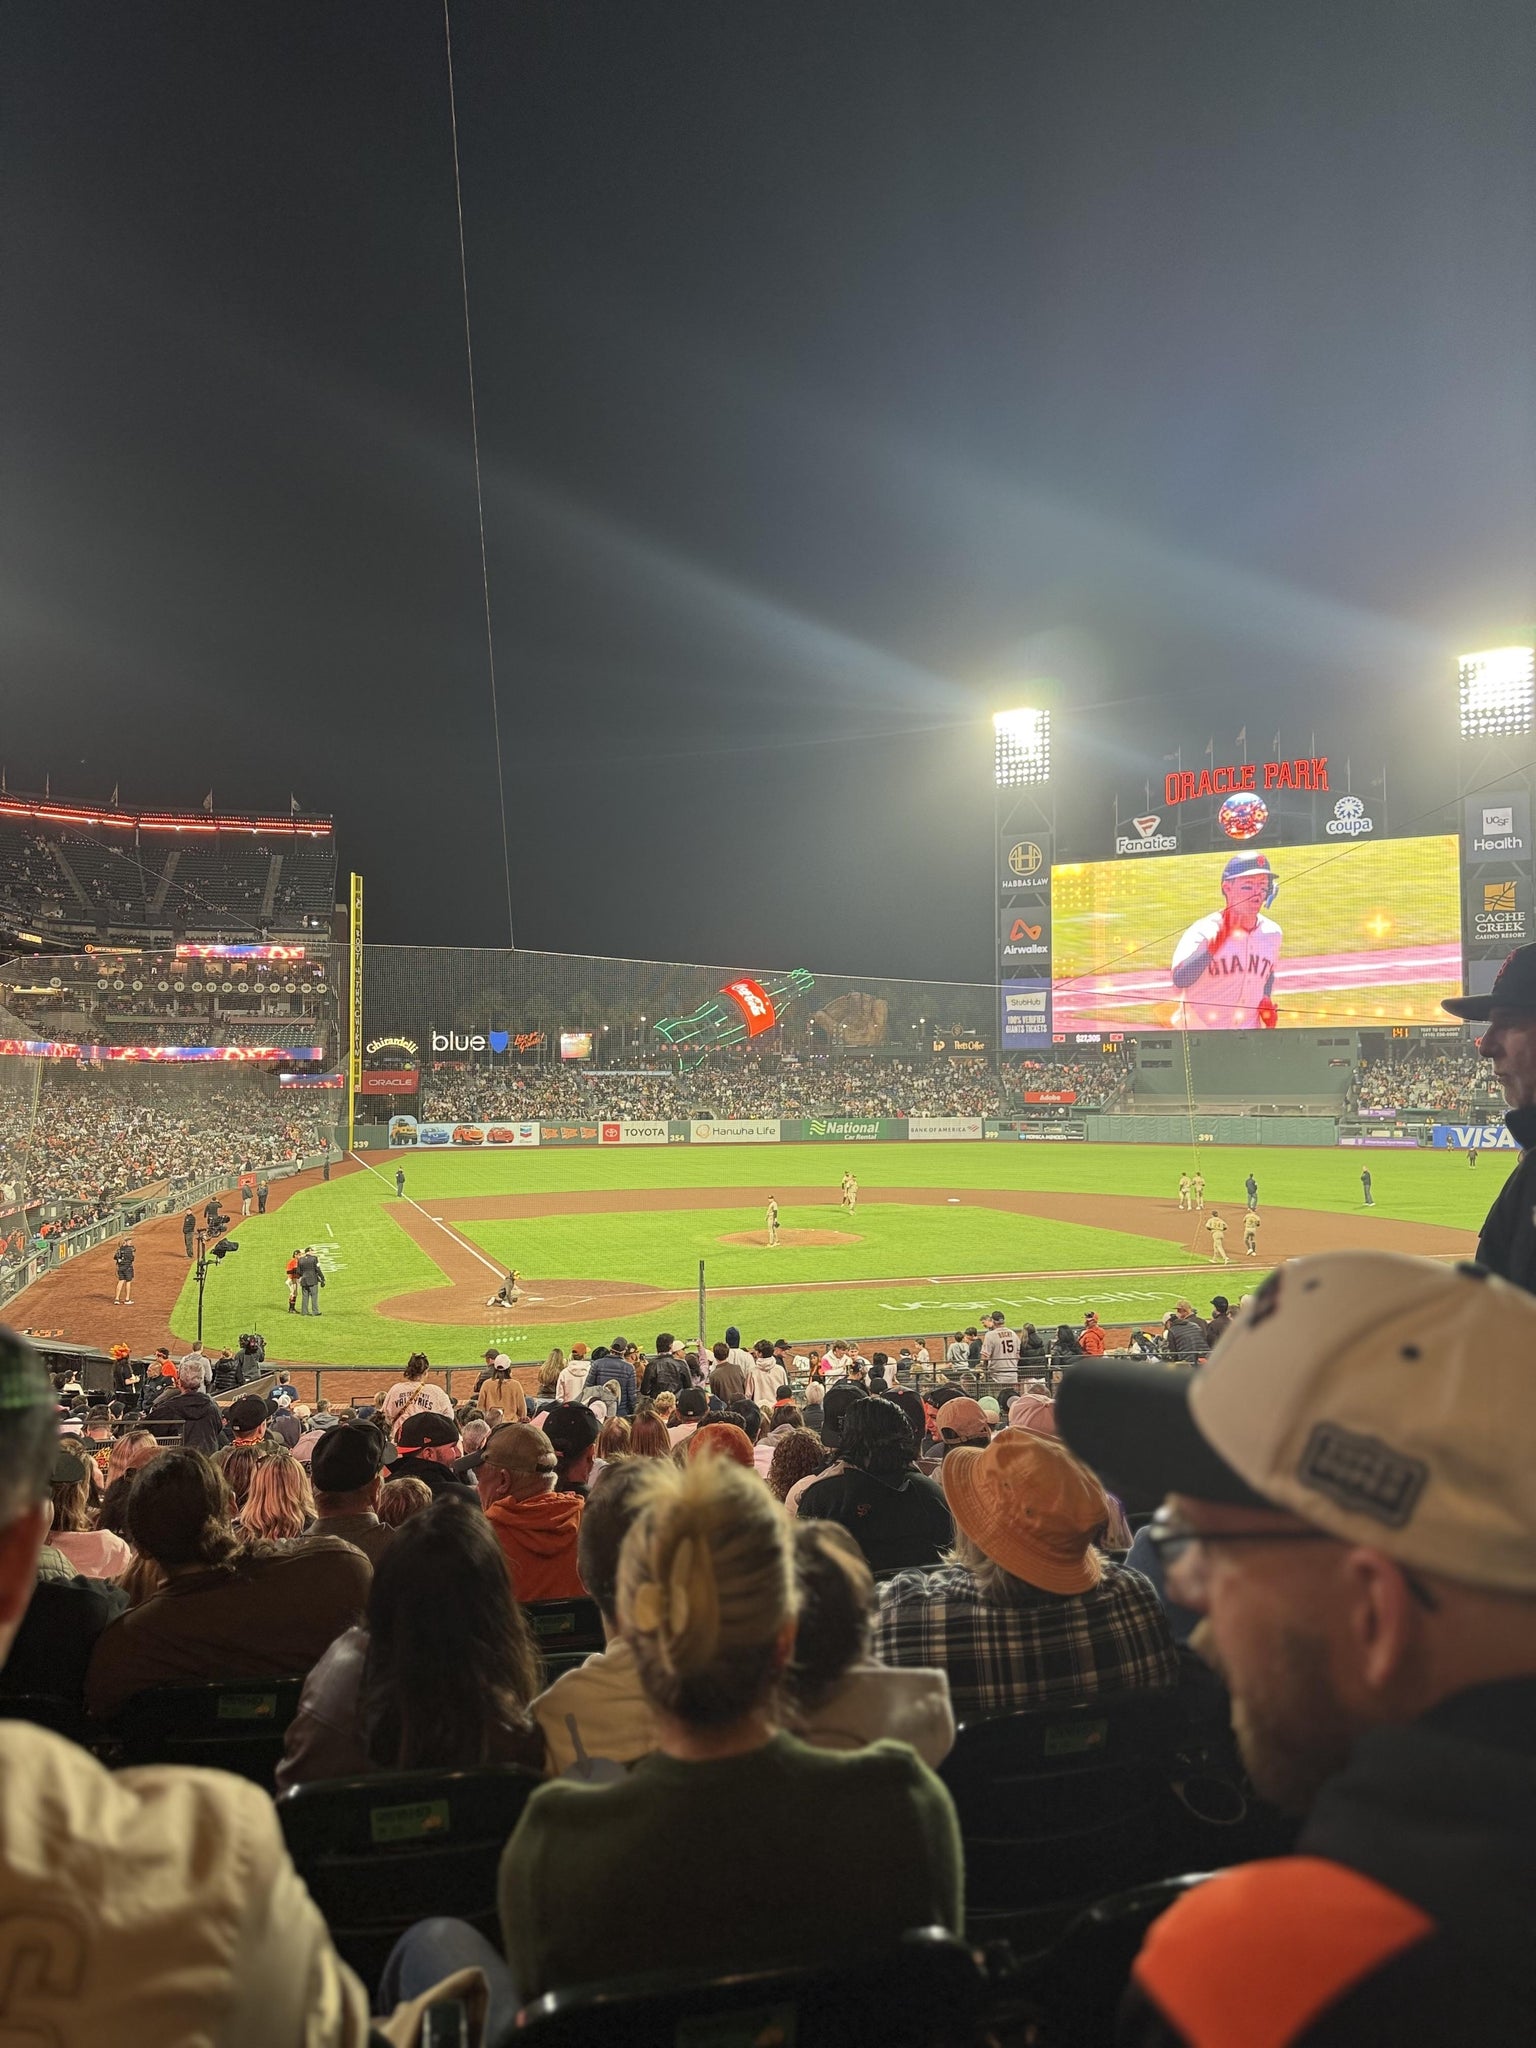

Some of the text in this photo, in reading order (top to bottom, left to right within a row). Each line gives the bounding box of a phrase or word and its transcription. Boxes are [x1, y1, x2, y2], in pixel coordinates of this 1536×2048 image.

[1165, 757, 1330, 806] ORACLE PARK
[1328, 819, 1371, 832] coupa
[1485, 816, 1509, 827] UCSF
[1119, 837, 1177, 851] Fanatics
[1473, 837, 1523, 851] Health
[1002, 878, 1049, 888] HABBAS LAW
[1474, 912, 1526, 923] CACHE
[1476, 922, 1525, 933] CREEK
[1003, 944, 1048, 955] Airwallex
[1011, 998, 1040, 1006] StubHub
[1008, 1015, 1046, 1025] 100% VERIFIED
[1006, 1024, 1047, 1033] GIANTS TICKETS
[366, 1036, 419, 1055] Ghirardelli
[432, 1031, 486, 1051] blue
[368, 1078, 412, 1086] ORACLE
[1039, 1093, 1061, 1101] Adobe
[624, 1128, 665, 1136] TOYOTA
[712, 1127, 776, 1135] Hanwha Life
[826, 1121, 879, 1134] National
[669, 1134, 685, 1142] 354
[1198, 1133, 1213, 1141] 391
[1452, 1127, 1516, 1148] VISA
[353, 1140, 368, 1149] 339
[879, 1290, 1187, 1311] UCSF Health
[1001, 1340, 1014, 1354] 15
[394, 1397, 433, 1411] VALYRIES
